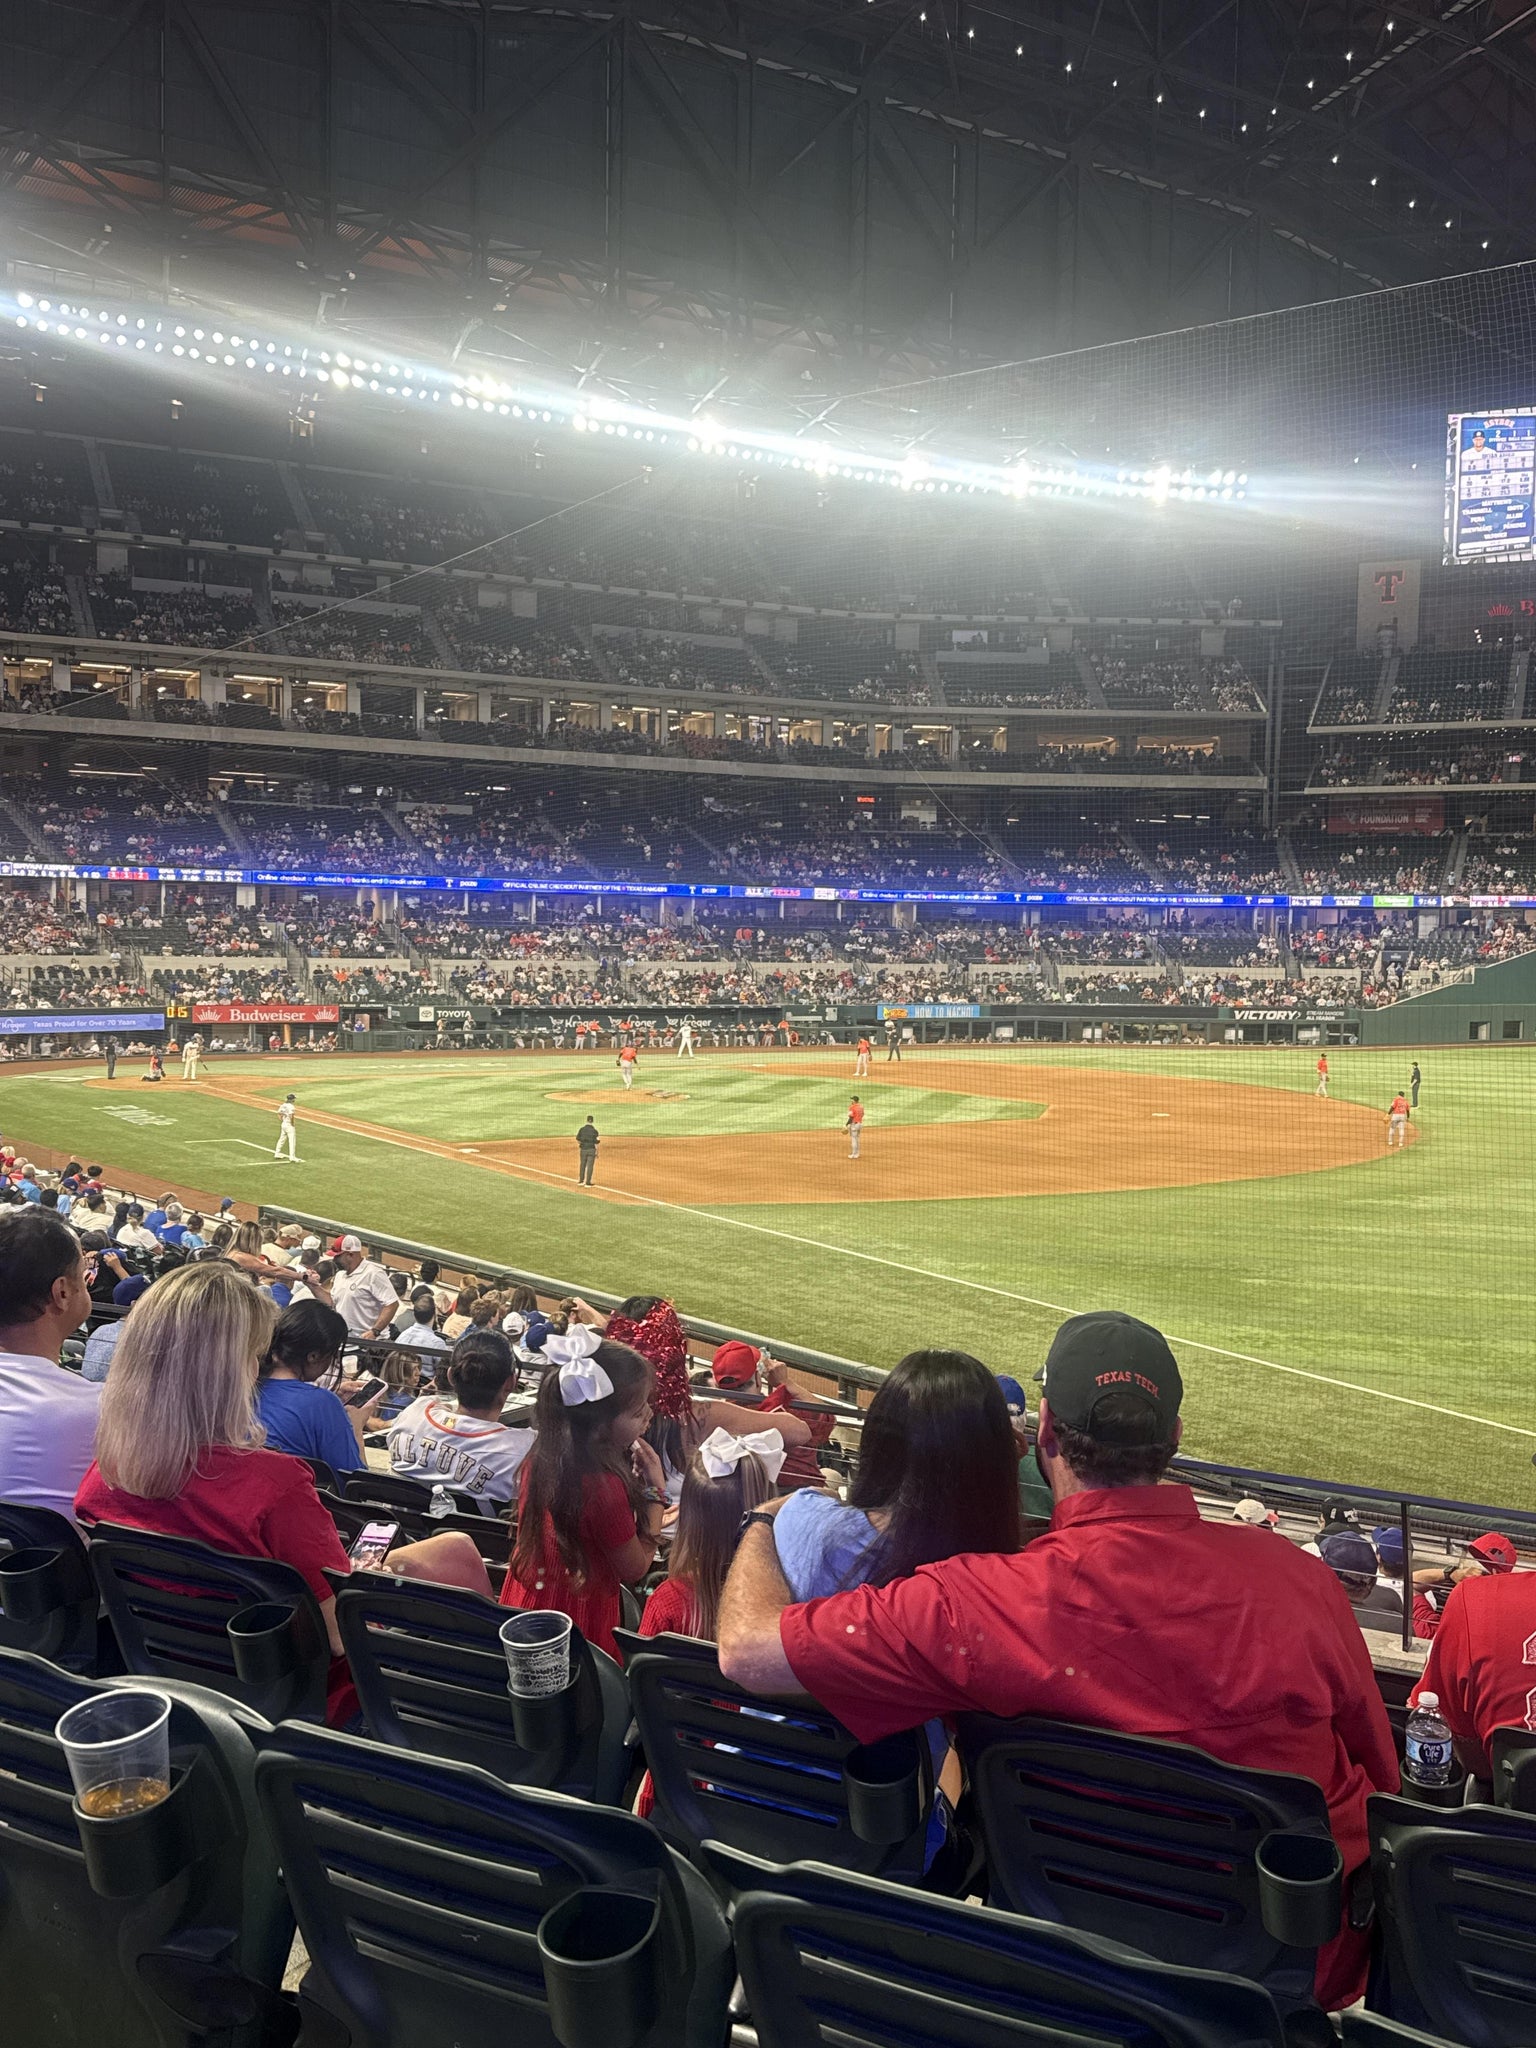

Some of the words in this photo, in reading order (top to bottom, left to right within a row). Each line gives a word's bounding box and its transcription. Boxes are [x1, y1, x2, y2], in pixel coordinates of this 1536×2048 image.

[1373, 569, 1405, 604] T
[745, 888, 763, 896] ALL
[229, 1009, 306, 1021] Budweiser
[436, 1010, 471, 1018] TOYOTA
[1234, 1010, 1297, 1020] VICTORY
[1095, 1371, 1131, 1387] TEXAS
[1134, 1373, 1160, 1398] TECH
[390, 1433, 494, 1494] ALTUVE
[1423, 1743, 1440, 1751] Pure
[1425, 1750, 1439, 1759] Life
